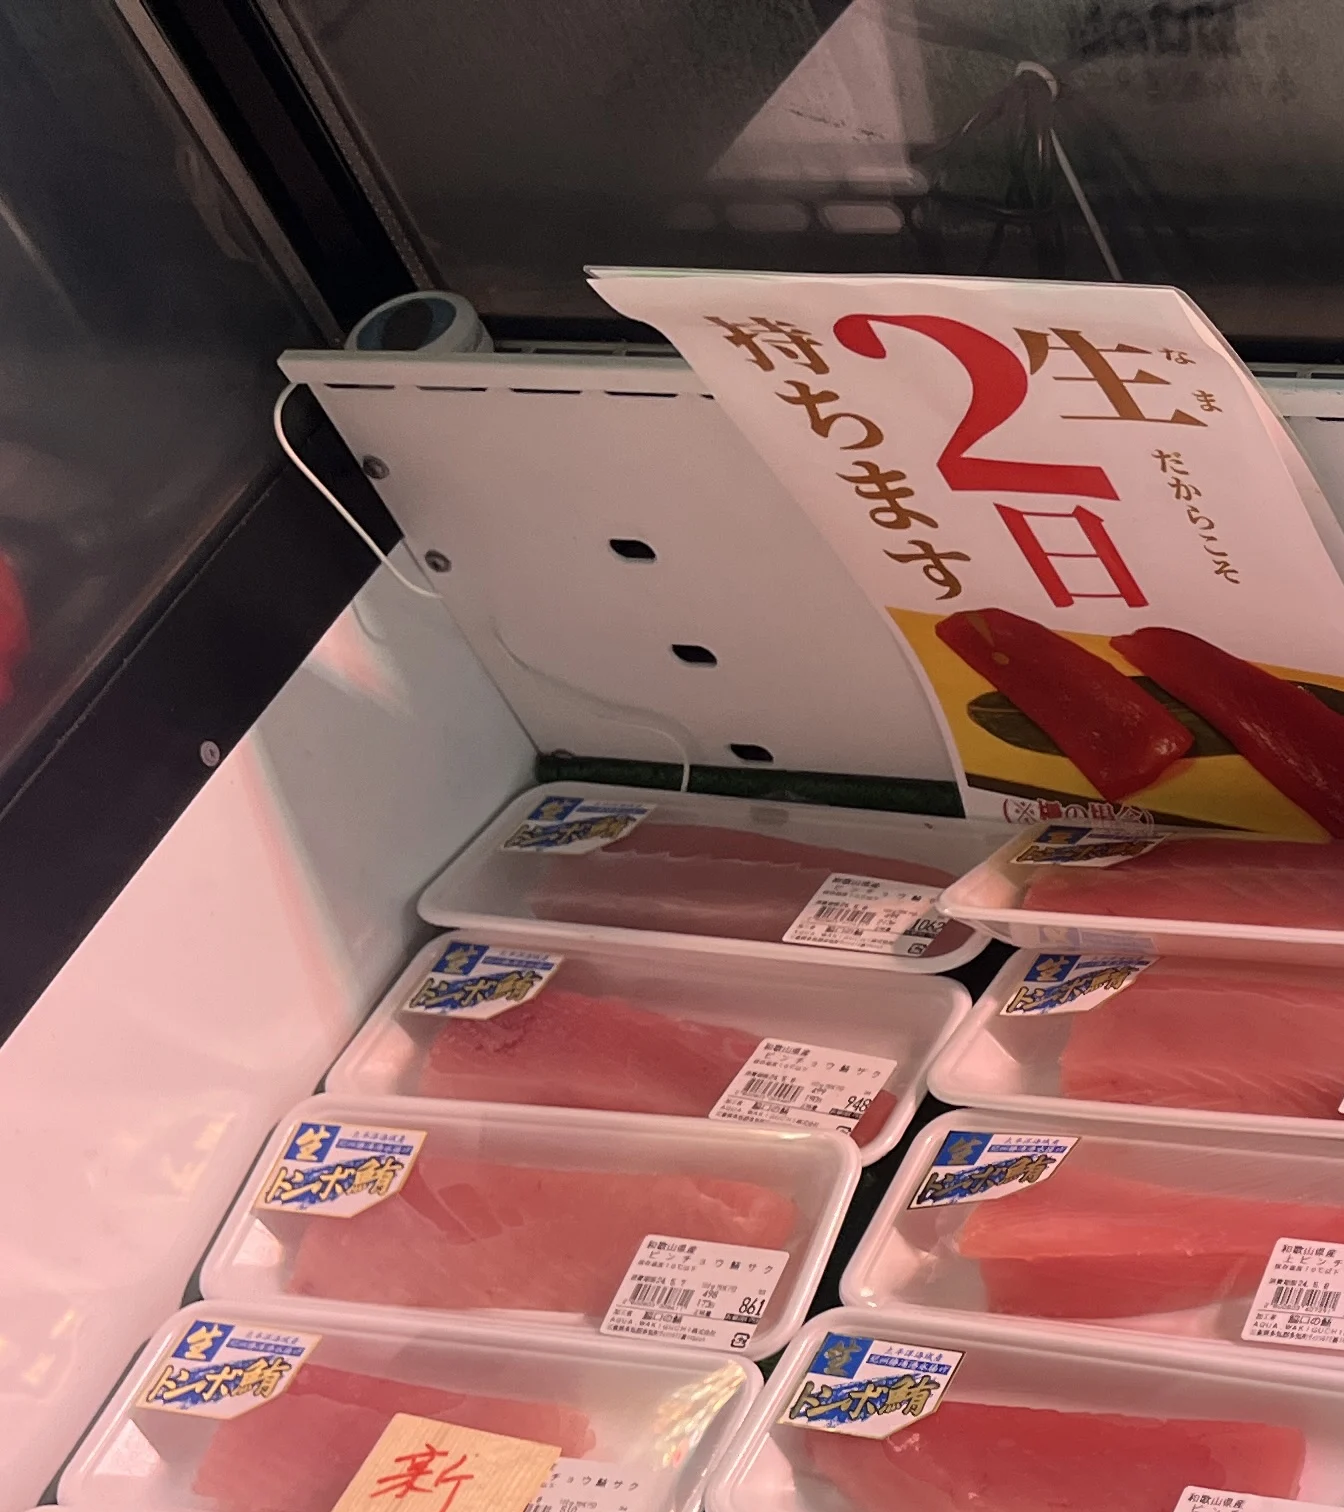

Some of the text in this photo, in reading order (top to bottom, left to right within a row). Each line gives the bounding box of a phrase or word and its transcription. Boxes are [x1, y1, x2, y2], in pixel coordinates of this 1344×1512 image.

[1011, 327, 1209, 428] 生
[1157, 346, 1221, 415] なま
[702, 313, 973, 601] 持ちます
[1151, 448, 1241, 585] だからこそ
[842, 1095, 873, 1111] 948
[294, 1124, 330, 1160] 生
[947, 1136, 984, 1163] 生
[262, 1156, 404, 1203] トンボ鮪
[913, 1154, 1055, 1204] トンボ鮪
[645, 1240, 697, 1255] 和歌山県産
[1280, 1244, 1336, 1258] 和歌山県産
[737, 1296, 766, 1316] 861
[181, 1325, 222, 1359] 生
[822, 1339, 861, 1376] 生
[141, 1356, 292, 1402] トンボ鮪
[786, 1374, 939, 1419] トンボ鮪
[1186, 1492, 1245, 1510] 和歌山県産
